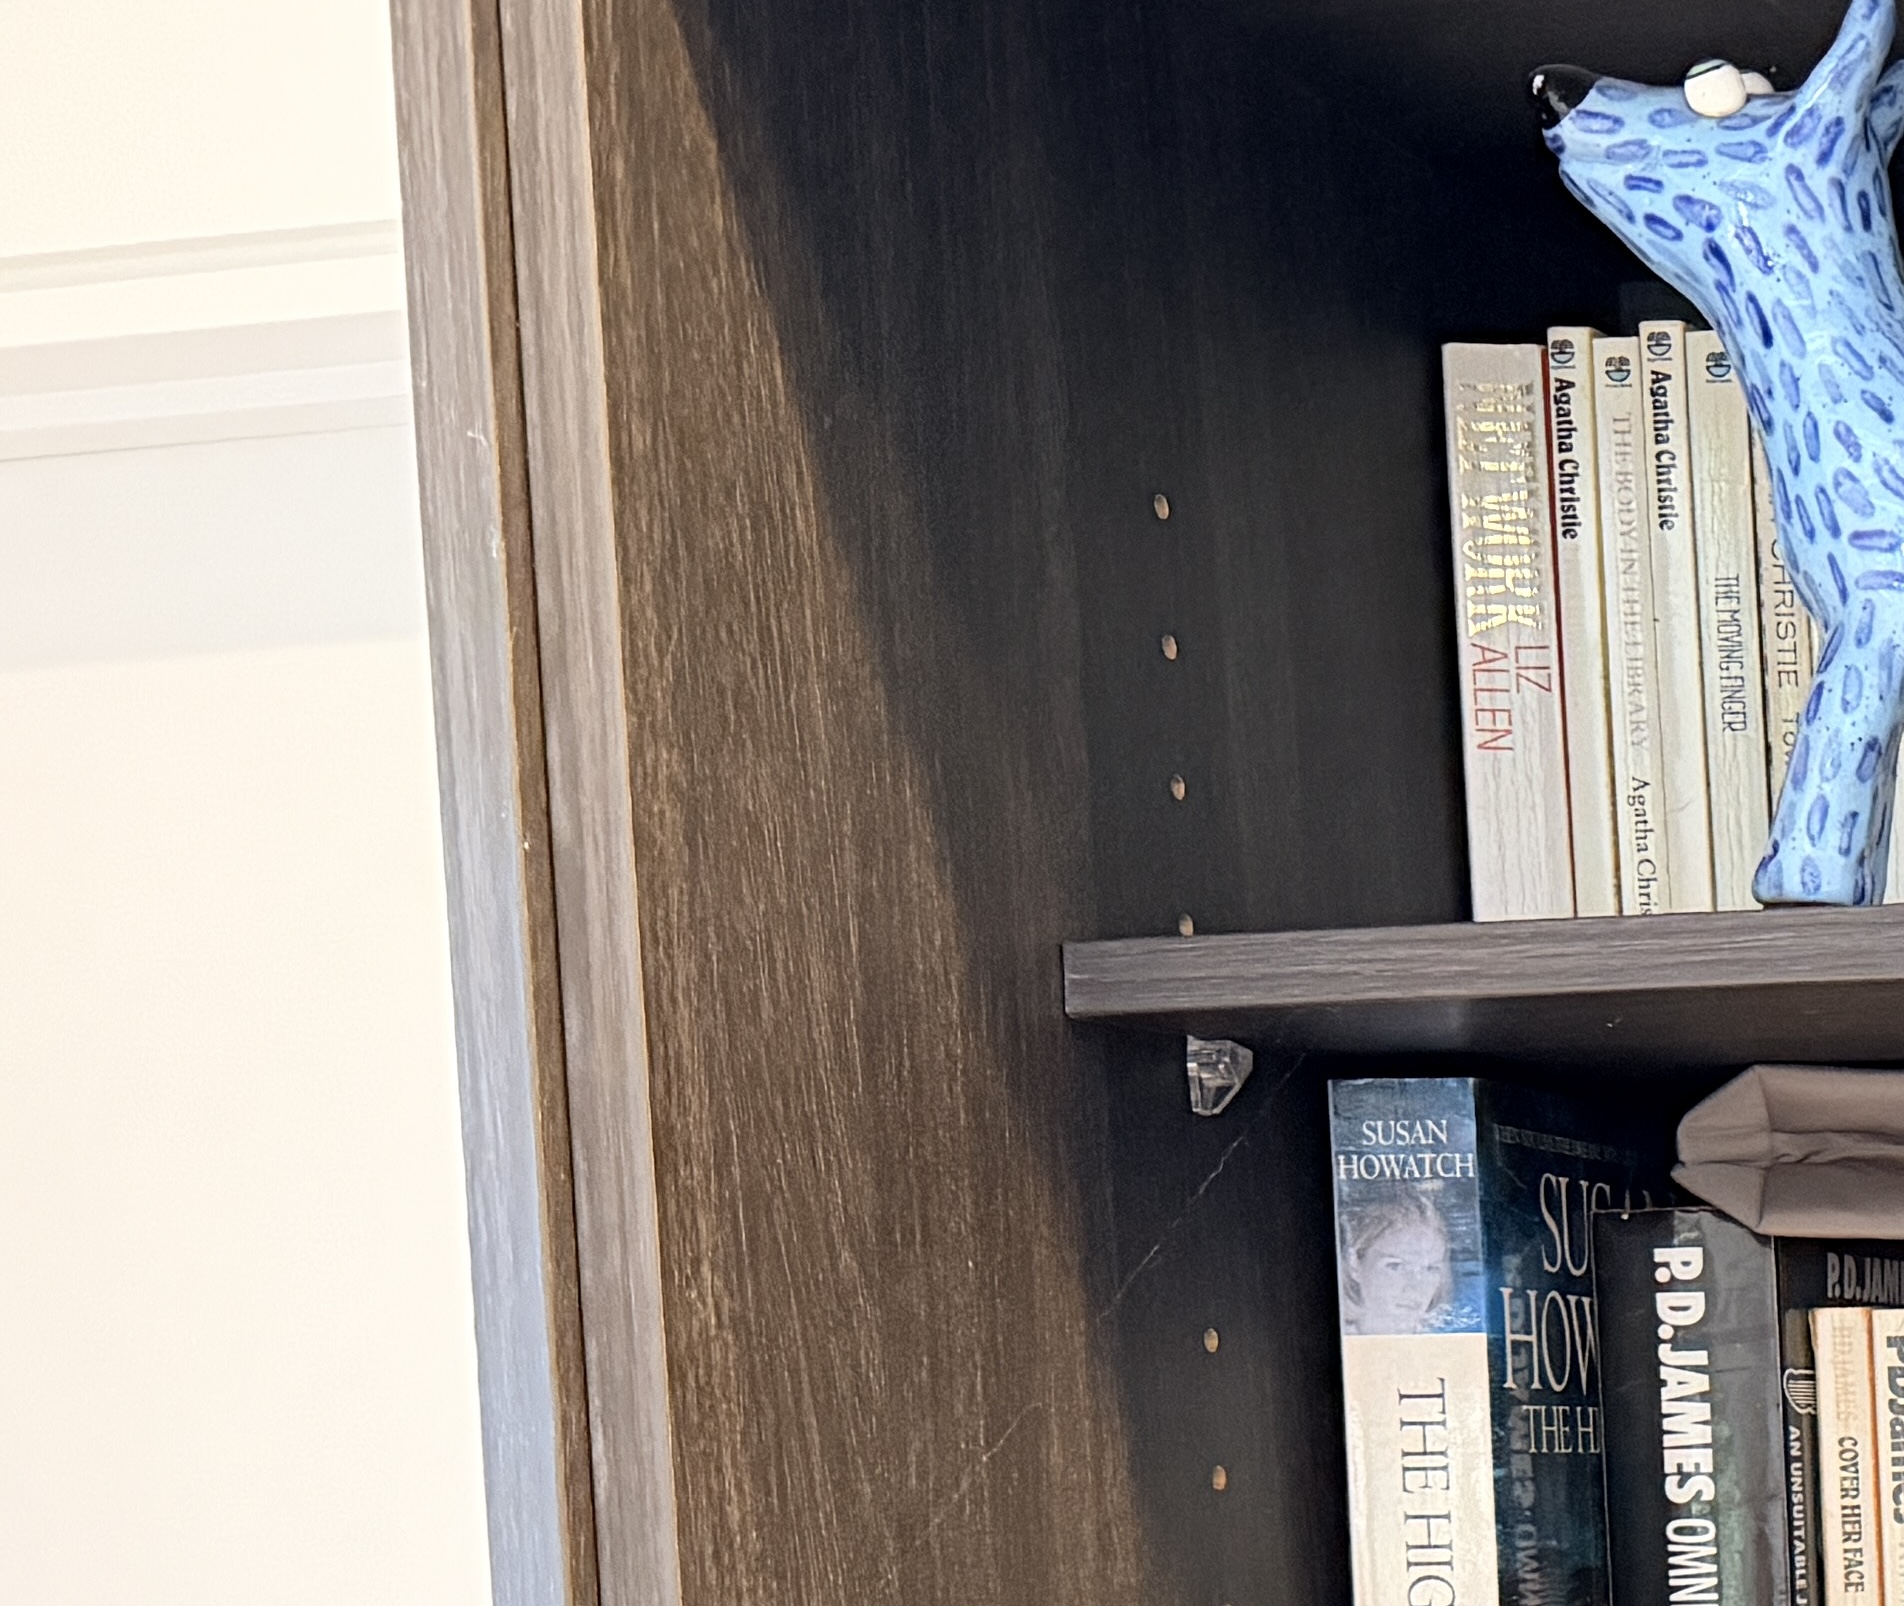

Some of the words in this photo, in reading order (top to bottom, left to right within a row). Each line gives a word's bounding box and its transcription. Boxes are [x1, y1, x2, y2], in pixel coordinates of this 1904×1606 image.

[1553, 376, 1576, 453] Agatha
[1558, 458, 1581, 541] Christie
[1715, 574, 1740, 604] THE
[1514, 643, 1551, 694] LIZ
[1715, 608, 1743, 672] MOVING
[1471, 642, 1513, 752] ALLEN
[1721, 673, 1747, 732] FINGER
[1362, 1120, 1447, 1145] SUSAN
[1338, 1153, 1475, 1179] HOWATCH
[1397, 1377, 1451, 1495] THE
[1837, 1436, 1860, 1496] COVER
[1840, 1502, 1862, 1536] HER
[1842, 1543, 1864, 1595] FACE
